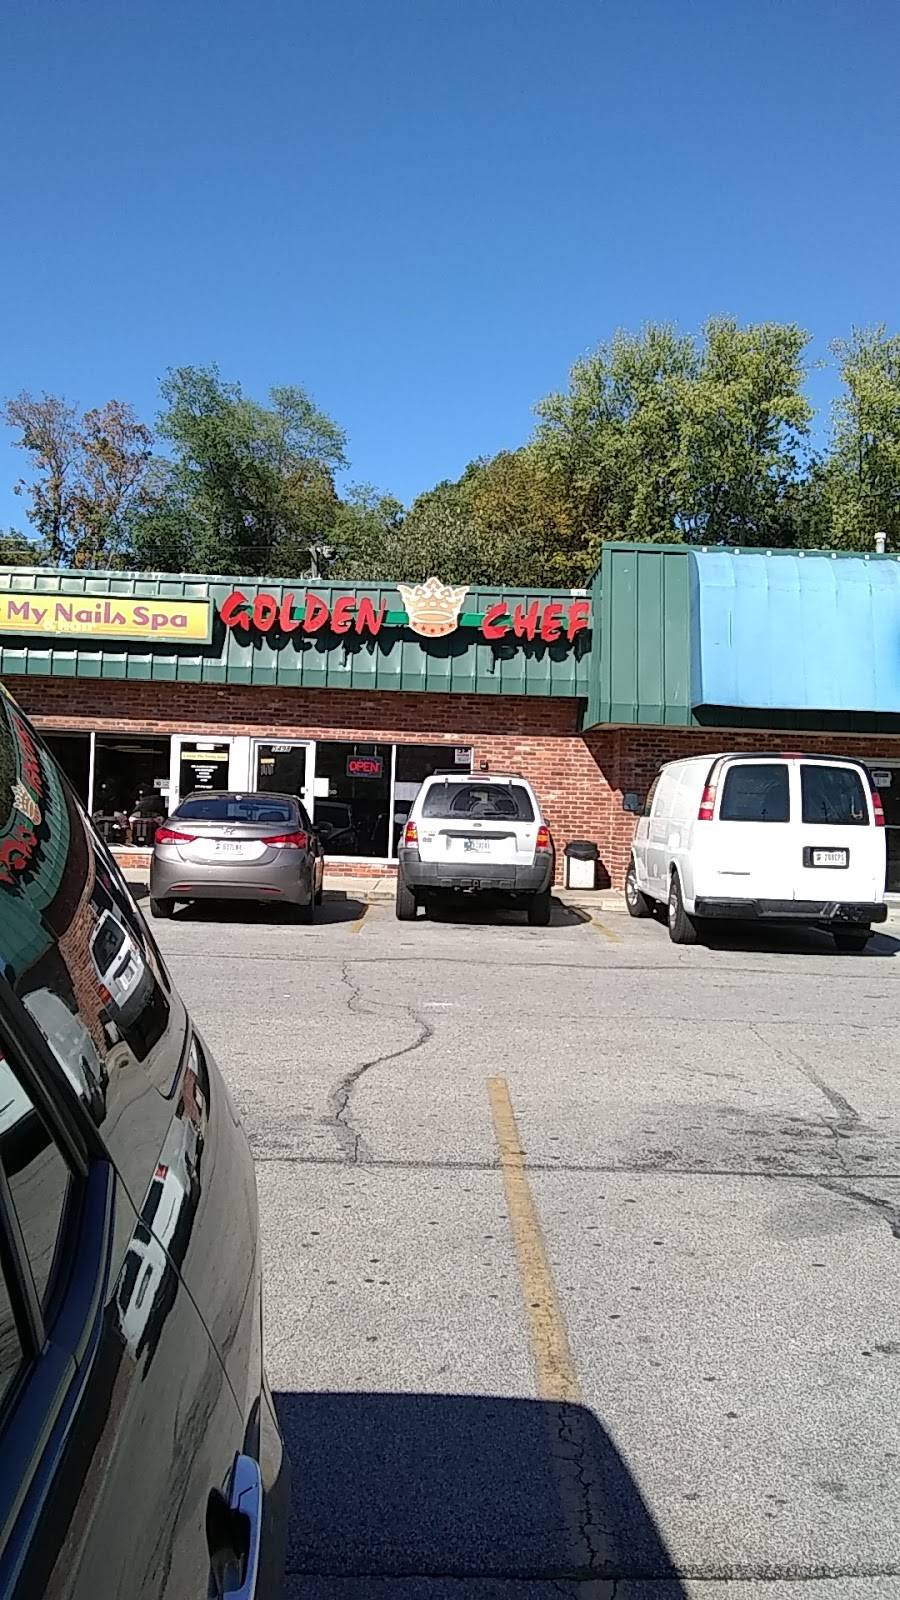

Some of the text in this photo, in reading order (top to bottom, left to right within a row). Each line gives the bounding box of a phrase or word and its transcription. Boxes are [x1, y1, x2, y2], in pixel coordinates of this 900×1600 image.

[7, 600, 187, 631] My Nails Spa
[220, 591, 591, 641] GOLDEN CHEF
[349, 760, 379, 774] OPEN
